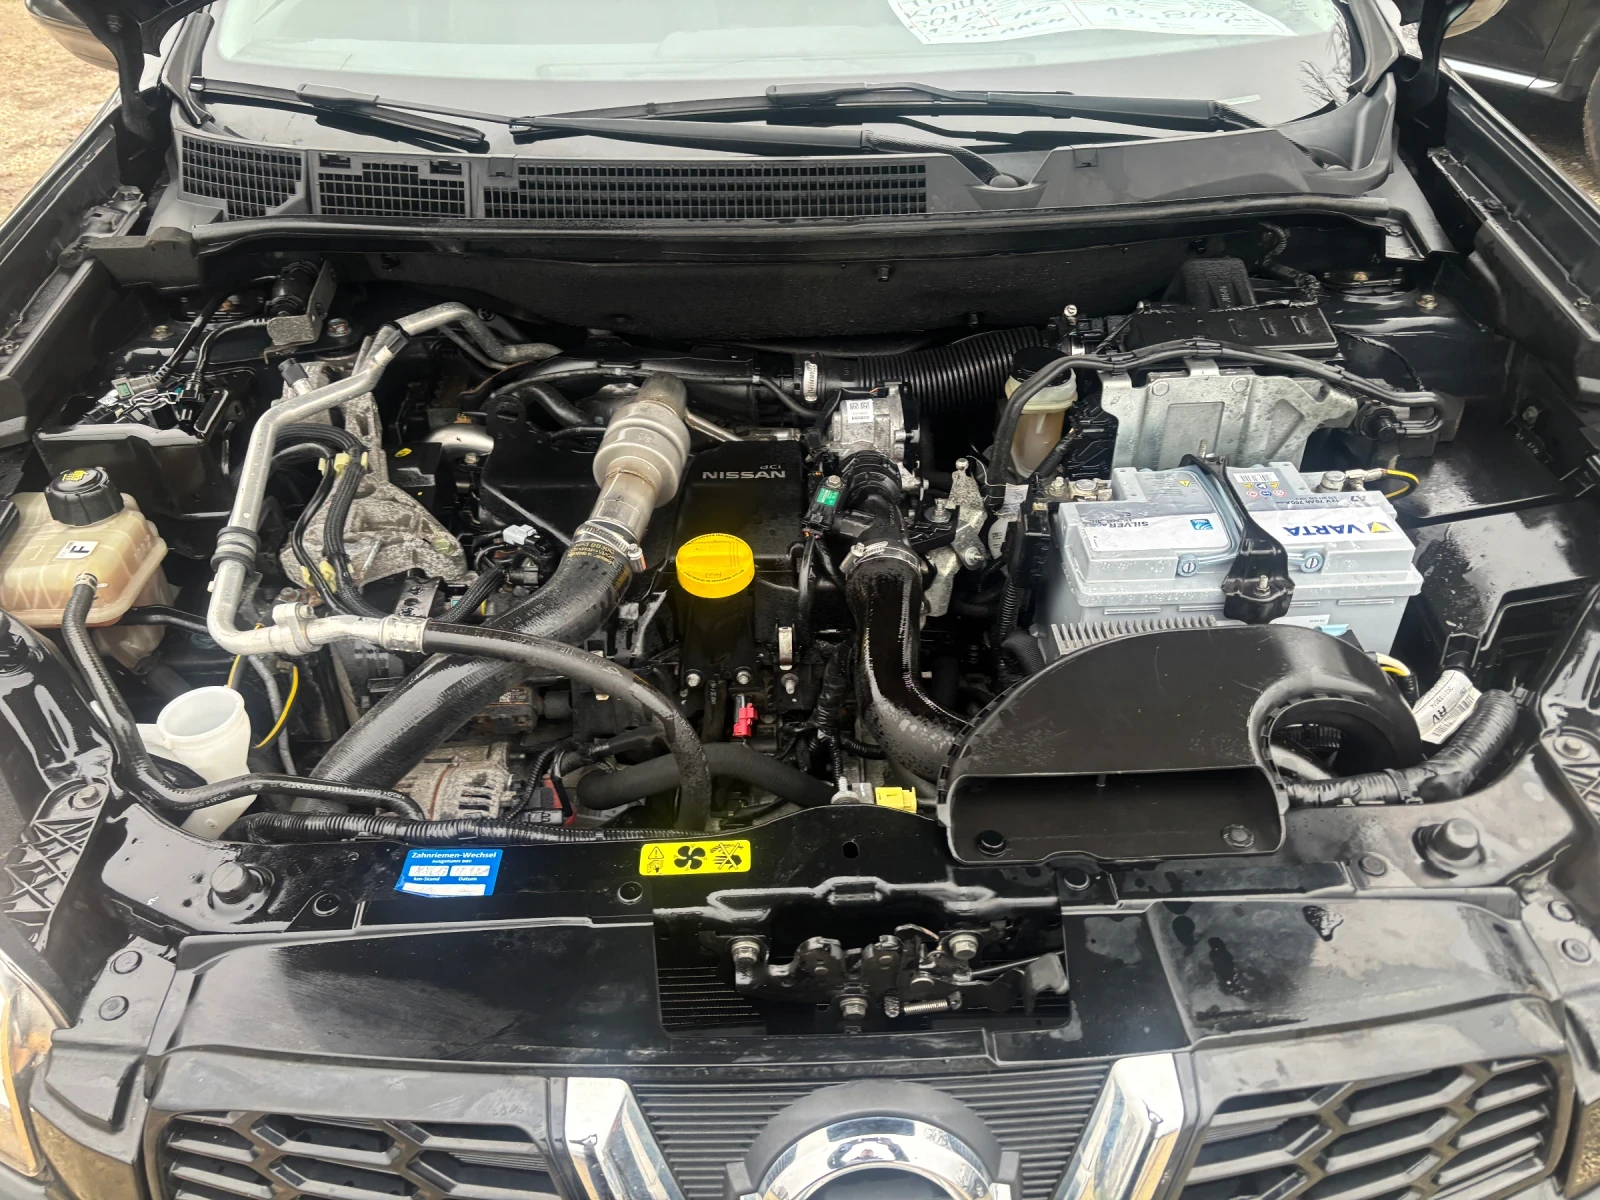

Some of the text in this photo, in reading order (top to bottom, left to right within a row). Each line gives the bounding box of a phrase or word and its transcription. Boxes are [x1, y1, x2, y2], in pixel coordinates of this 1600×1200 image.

[702, 470, 786, 480] NISSAN
[1108, 521, 1149, 529] SILVER
[1282, 523, 1366, 537] VARTA
[69, 545, 90, 554] F
[1432, 706, 1448, 725] RV
[411, 851, 497, 859] Zahnriemen-Wechsel
